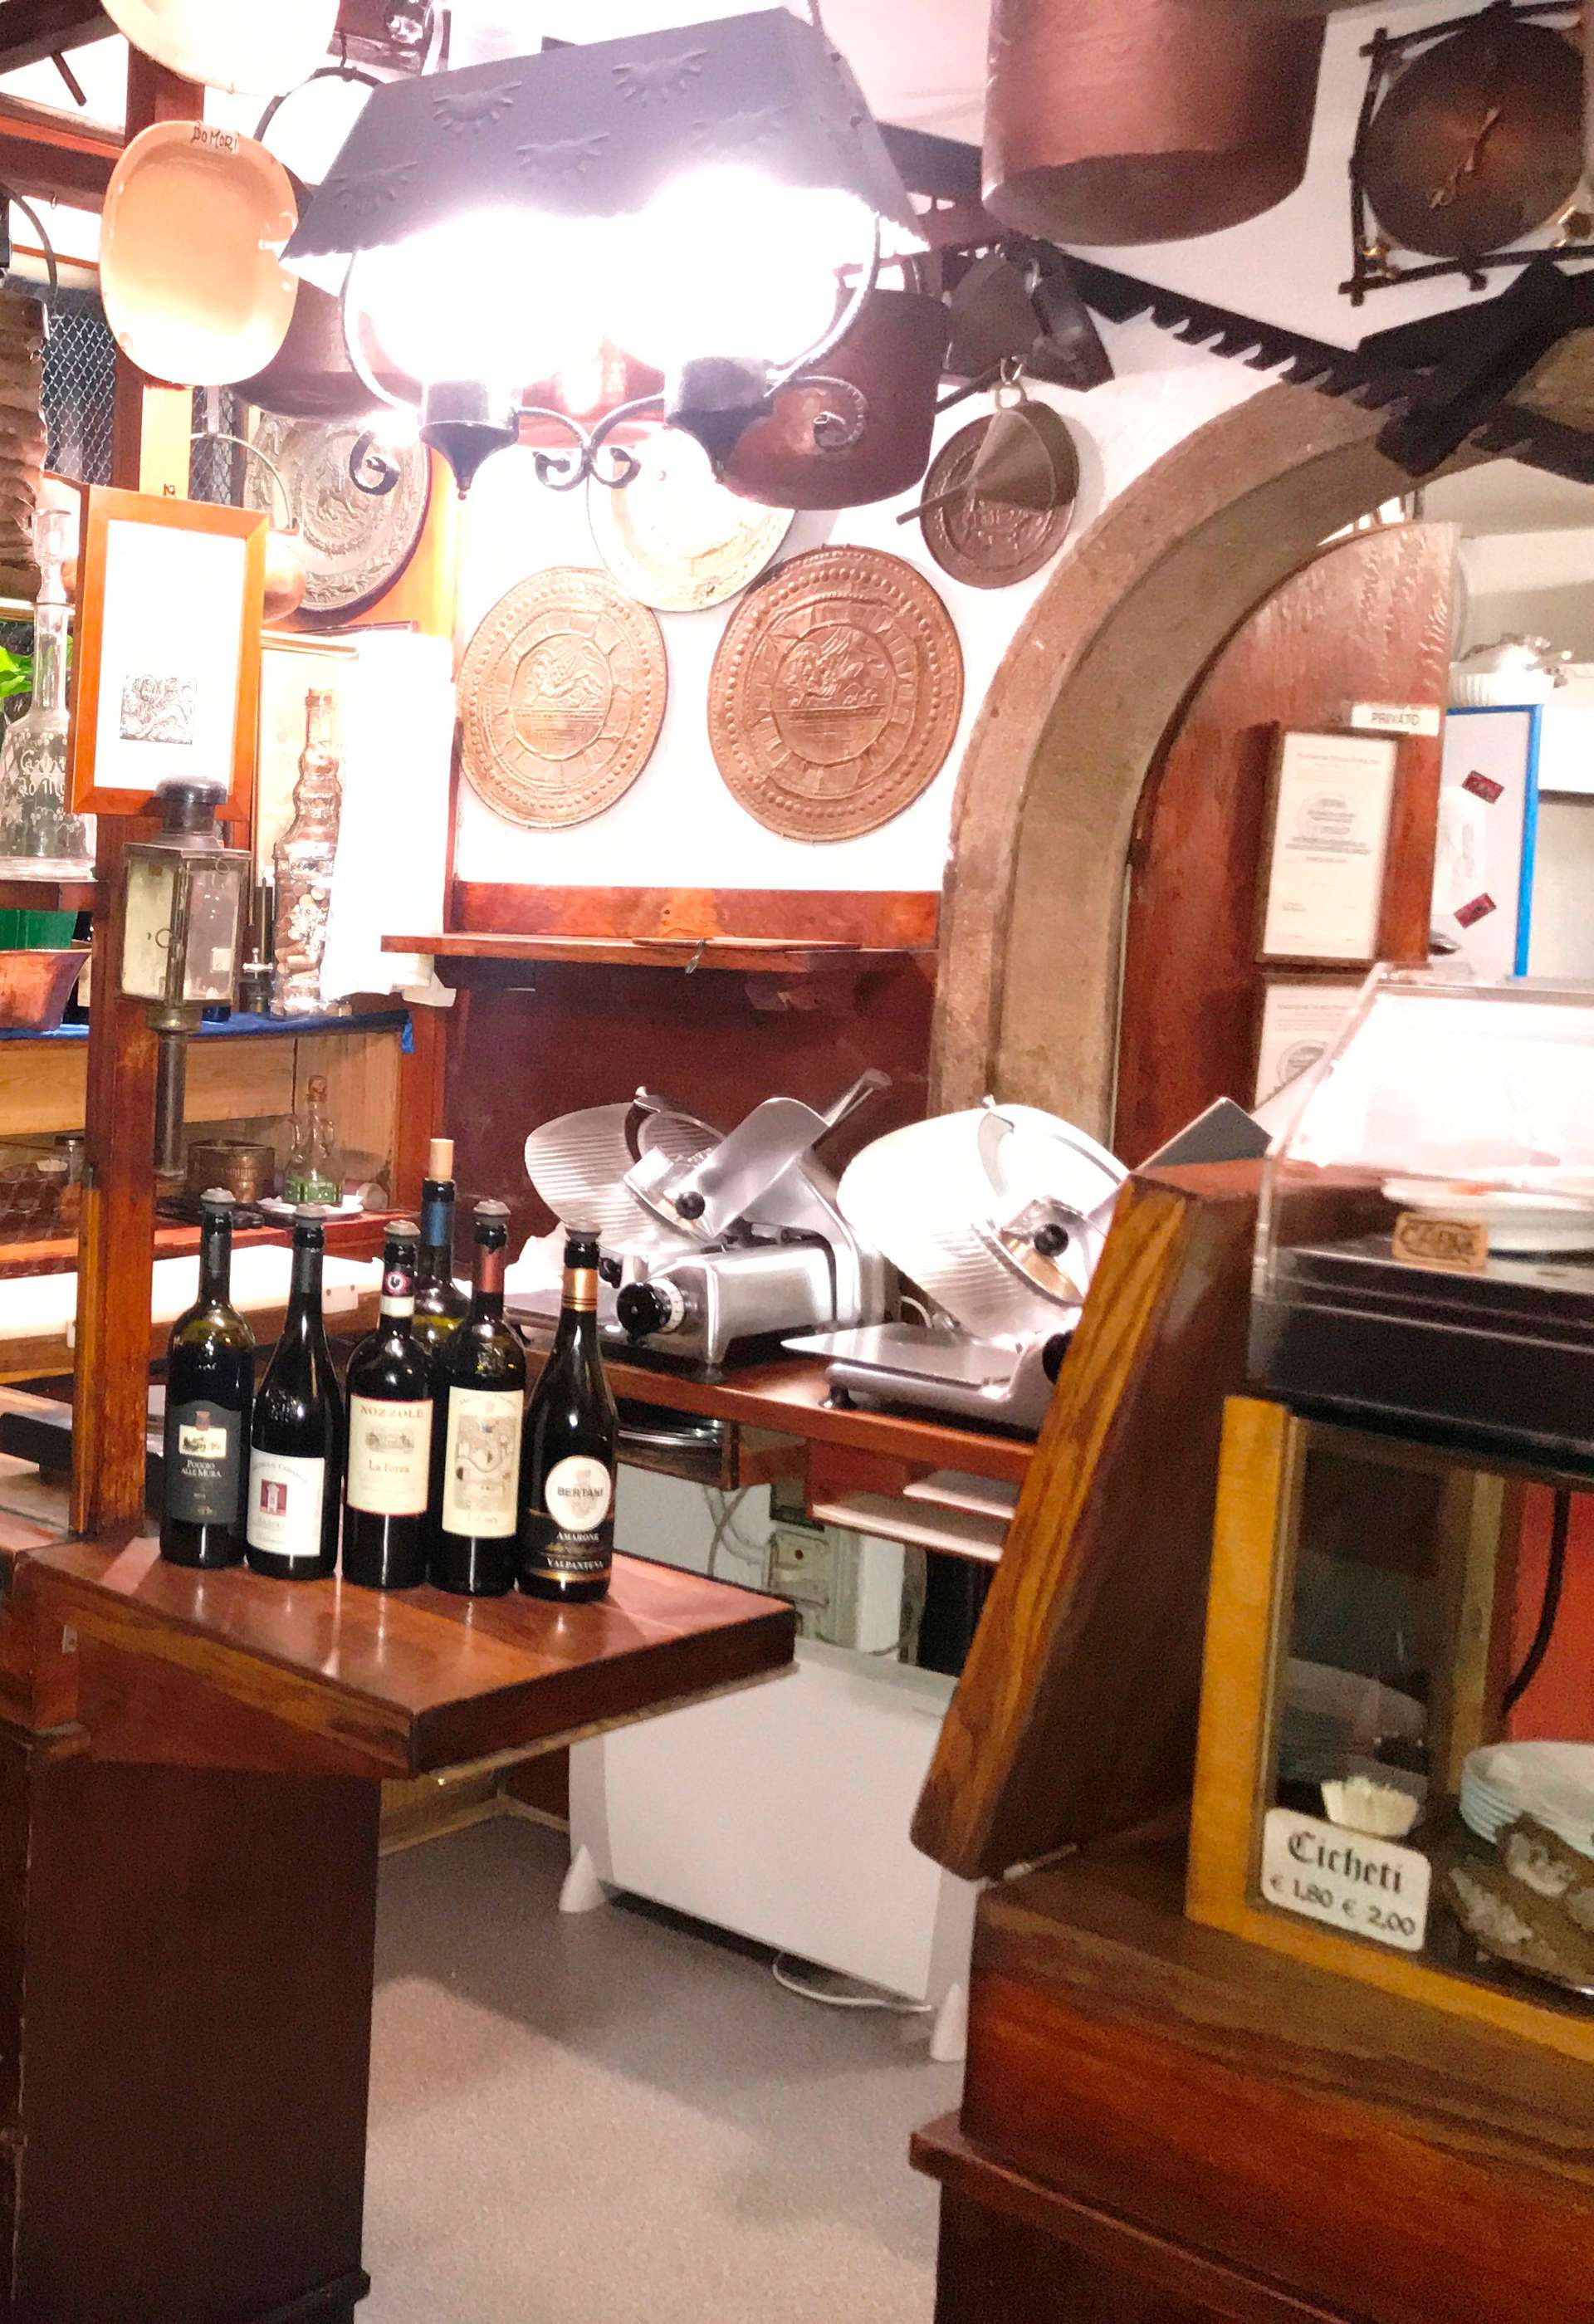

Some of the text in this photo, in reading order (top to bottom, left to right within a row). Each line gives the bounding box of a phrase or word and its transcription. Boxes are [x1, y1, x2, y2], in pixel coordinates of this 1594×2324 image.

[1372, 712, 1420, 726] PRIVATO
[360, 1405, 425, 1418] NOZZOLE
[558, 1486, 604, 1497] BERTANI
[1288, 1831, 1401, 1895] Cicheti
[1342, 1898, 1357, 1919] €
